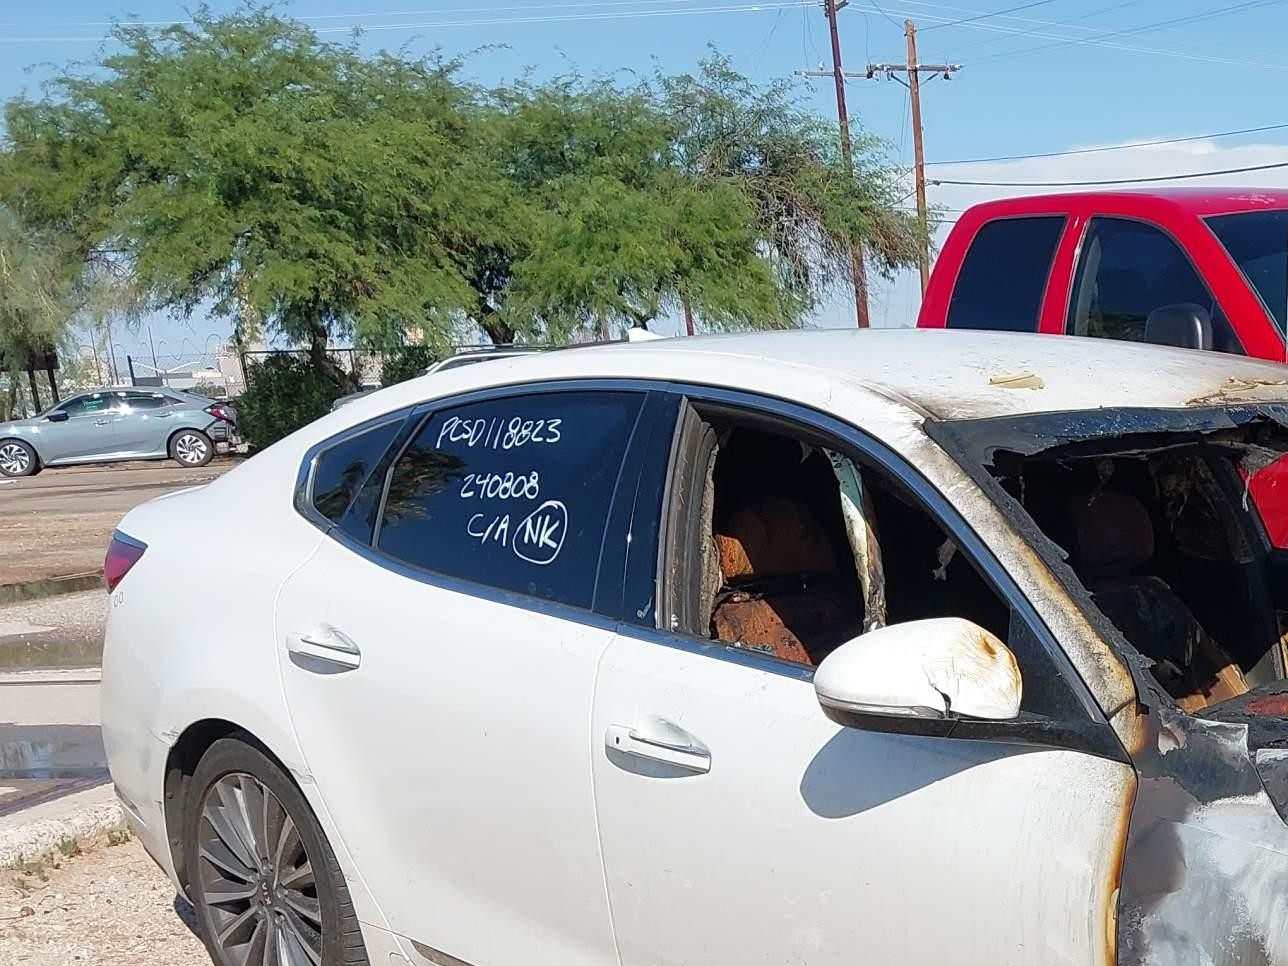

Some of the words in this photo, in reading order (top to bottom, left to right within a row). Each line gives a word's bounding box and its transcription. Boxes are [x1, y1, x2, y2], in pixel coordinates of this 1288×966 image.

[435, 415, 562, 450] PCSD118823
[460, 470, 539, 499] 240808
[466, 513, 510, 547] C/A
